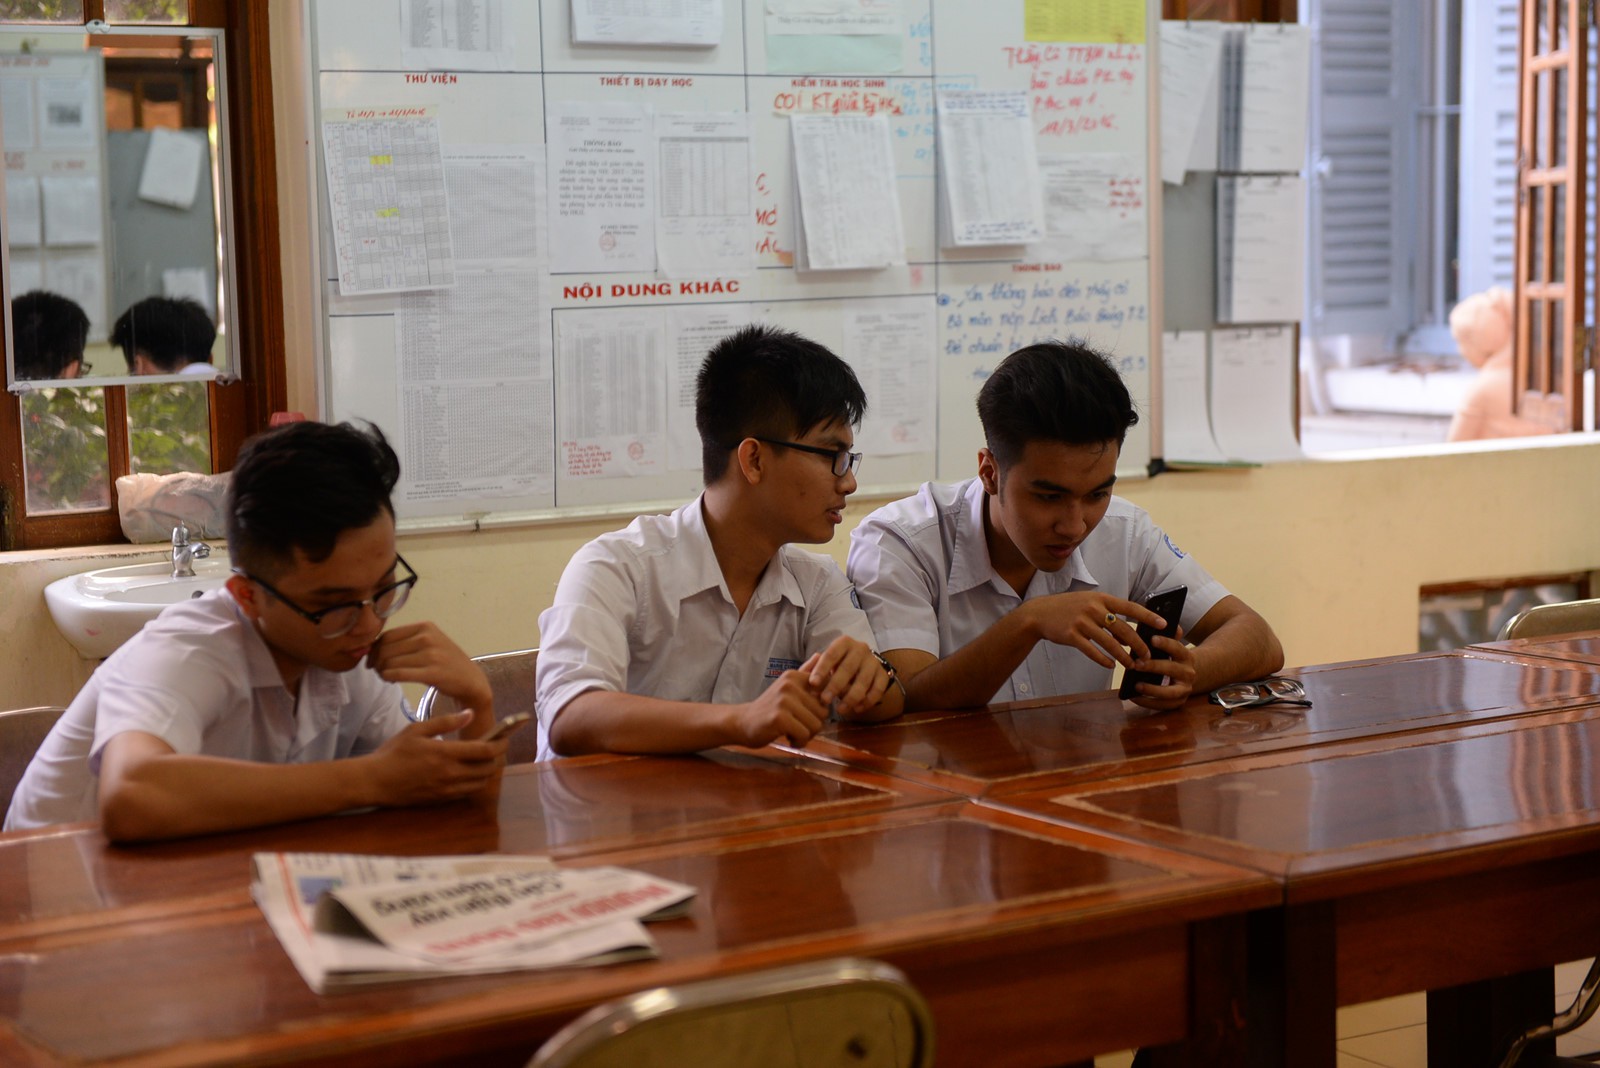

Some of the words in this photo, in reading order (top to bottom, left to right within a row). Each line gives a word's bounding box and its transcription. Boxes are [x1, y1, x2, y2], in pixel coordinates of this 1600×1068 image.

[405, 73, 428, 84] THƯ
[431, 72, 457, 85] VIỆN
[599, 74, 630, 86] THIẾT
[820, 79, 838, 87] TRA
[863, 80, 886, 88] SINH
[563, 283, 602, 301] NỘI
[610, 283, 672, 298] DUNG
[679, 278, 740, 295] KHÁC
